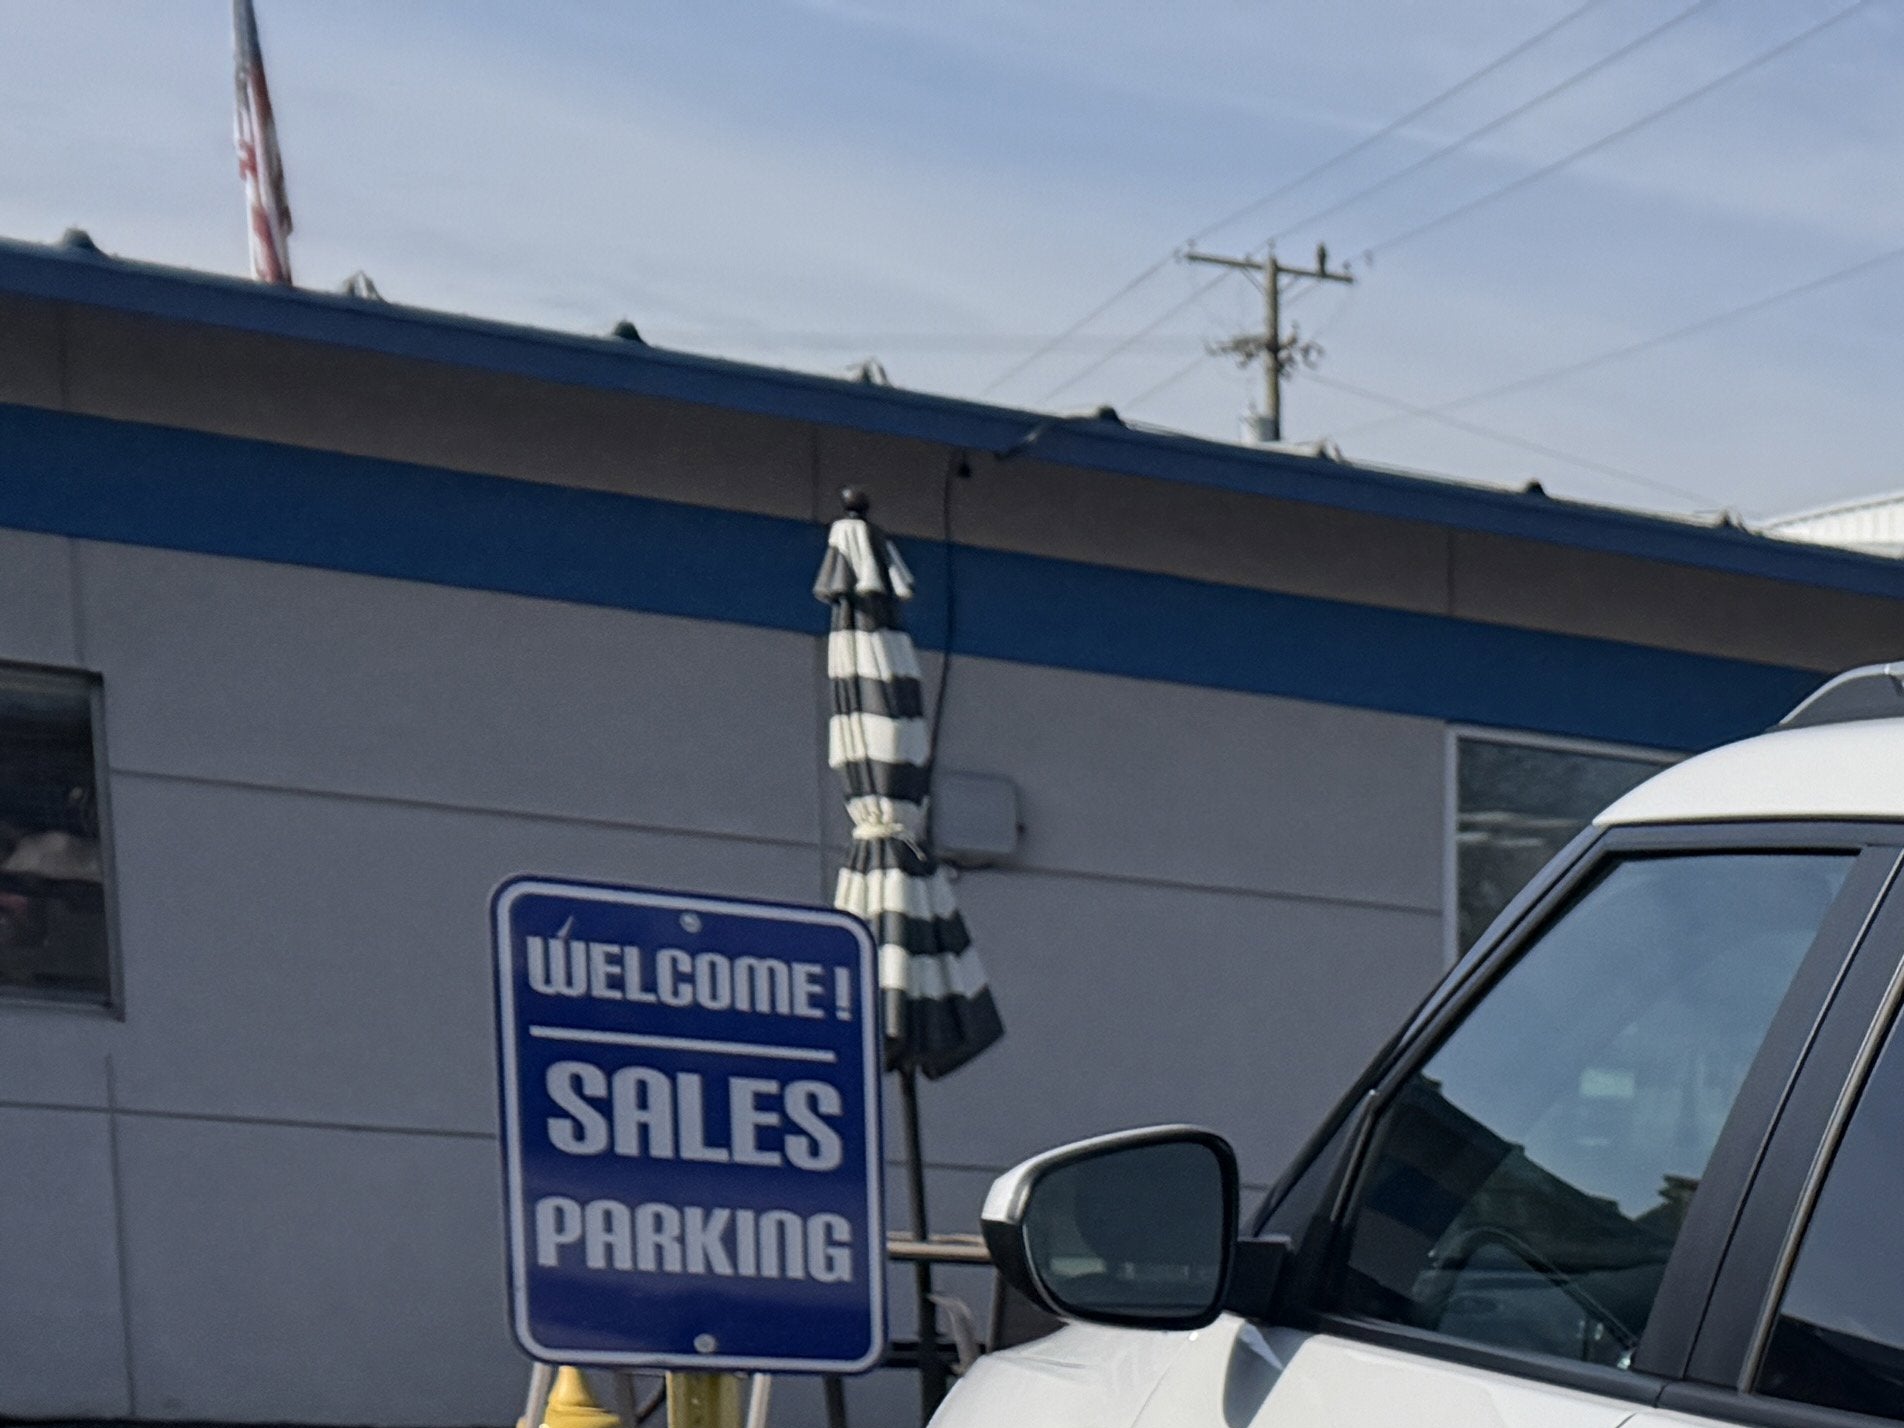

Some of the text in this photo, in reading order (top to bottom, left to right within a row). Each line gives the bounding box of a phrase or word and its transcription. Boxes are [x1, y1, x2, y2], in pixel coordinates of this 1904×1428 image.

[526, 917, 853, 1021] WELCOME!
[544, 1060, 844, 1172] SALES
[534, 1196, 853, 1283] PARKING
